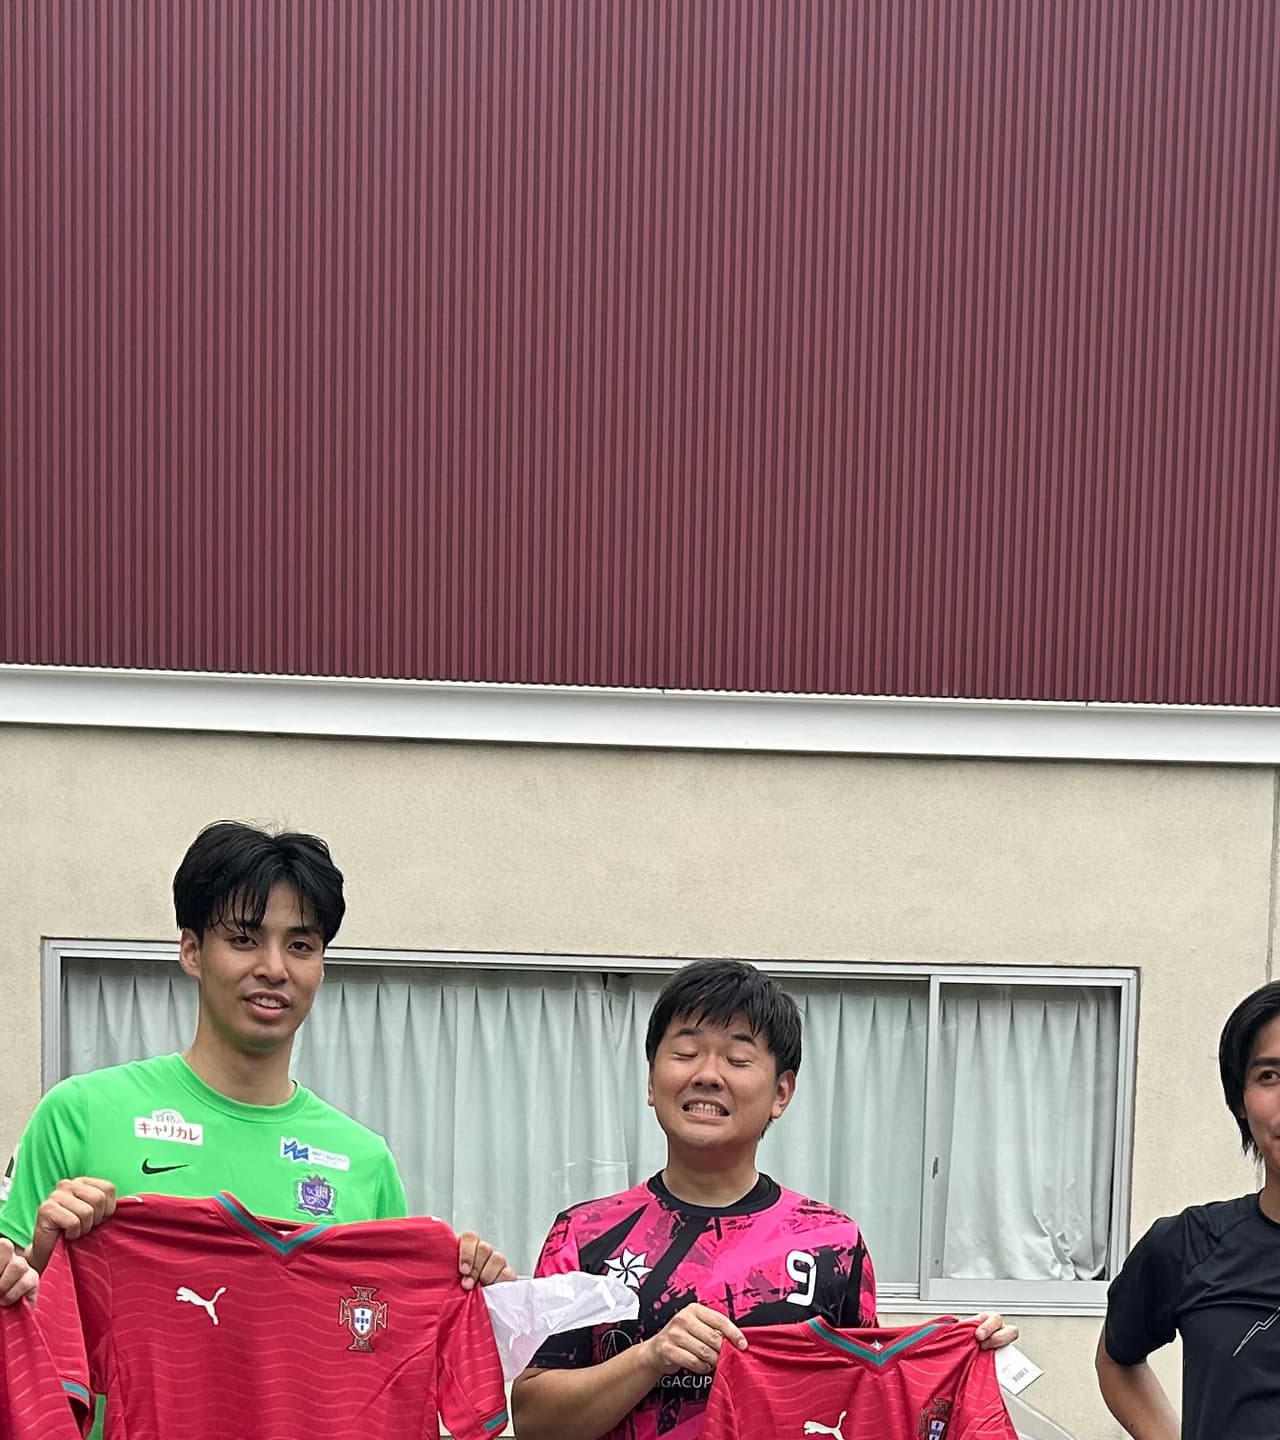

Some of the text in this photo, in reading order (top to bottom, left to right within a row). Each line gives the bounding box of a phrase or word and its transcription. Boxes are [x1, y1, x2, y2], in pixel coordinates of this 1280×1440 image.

[138, 1121, 200, 1142] キャリカレ
[786, 1250, 817, 1306] 9
